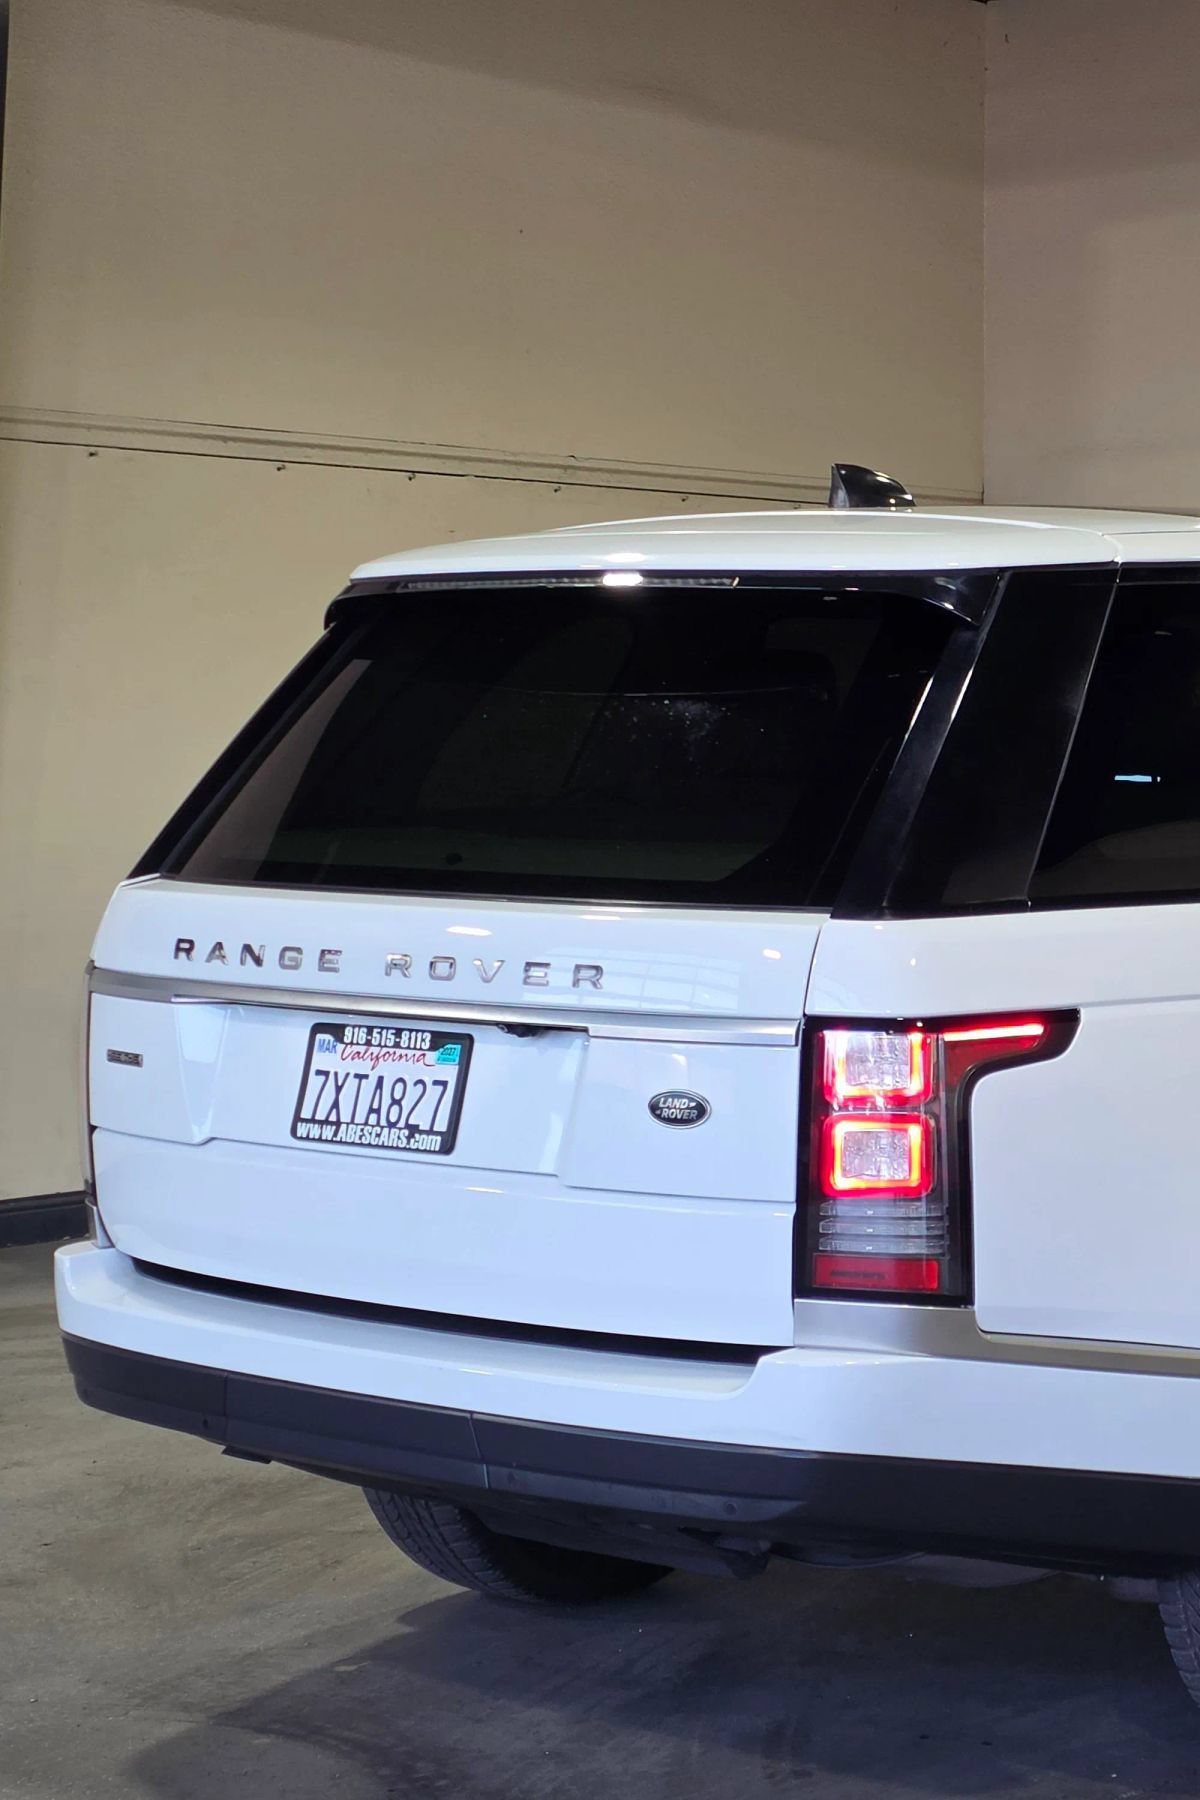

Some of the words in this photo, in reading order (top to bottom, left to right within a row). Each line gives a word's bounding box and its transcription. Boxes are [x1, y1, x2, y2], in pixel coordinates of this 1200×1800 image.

[173, 937, 343, 973] RANGE
[384, 952, 605, 990] ROVER
[343, 1026, 431, 1050] 916-515-8113
[340, 1044, 436, 1071] California
[311, 1069, 449, 1132] 7XTA827
[659, 1097, 689, 1109] LAND
[661, 1108, 698, 1120] ROVER
[296, 1121, 442, 1151] www.ABESCARS.com
